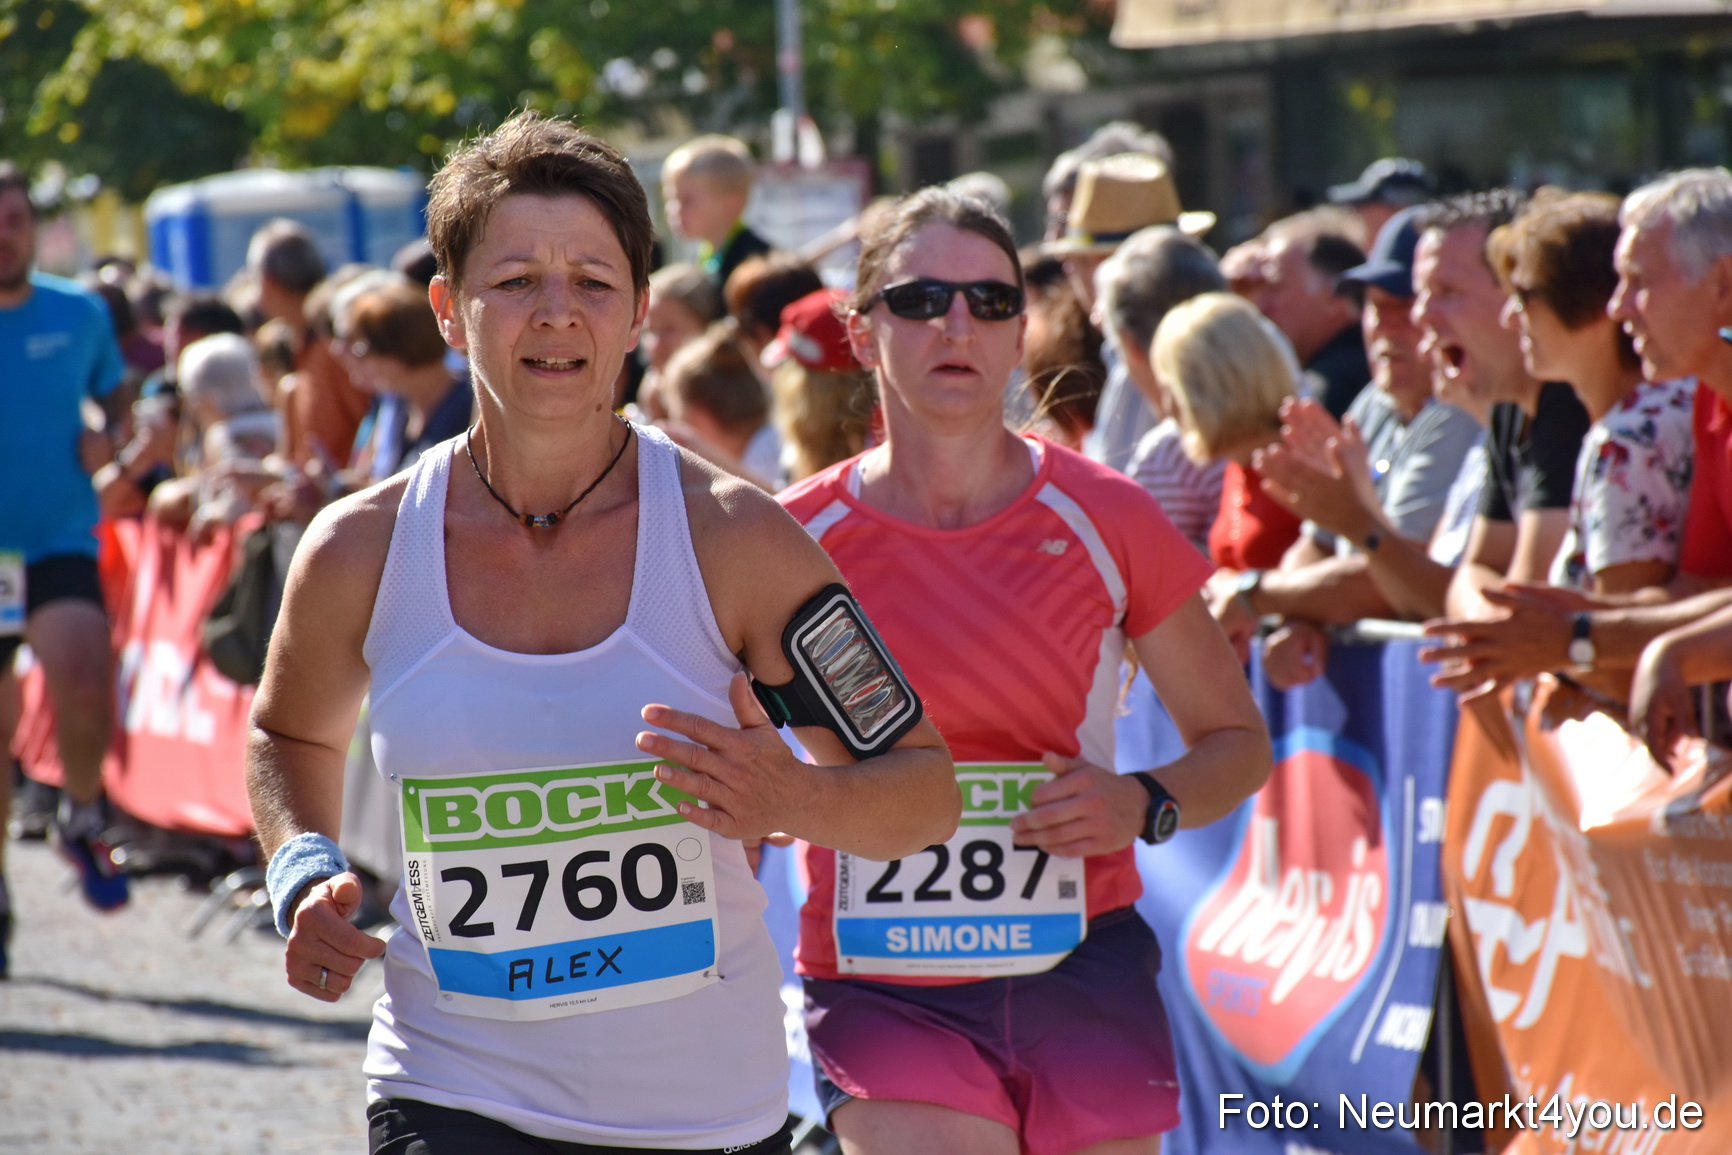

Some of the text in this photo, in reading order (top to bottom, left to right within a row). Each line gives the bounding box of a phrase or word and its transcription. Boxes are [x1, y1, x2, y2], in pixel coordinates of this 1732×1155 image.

[424, 777, 665, 836] BOCK
[957, 777, 1036, 813] CK
[440, 842, 678, 938] 2760
[865, 839, 1051, 904] 2287
[886, 923, 1032, 952] SIMONE
[508, 945, 623, 992] ALEX
